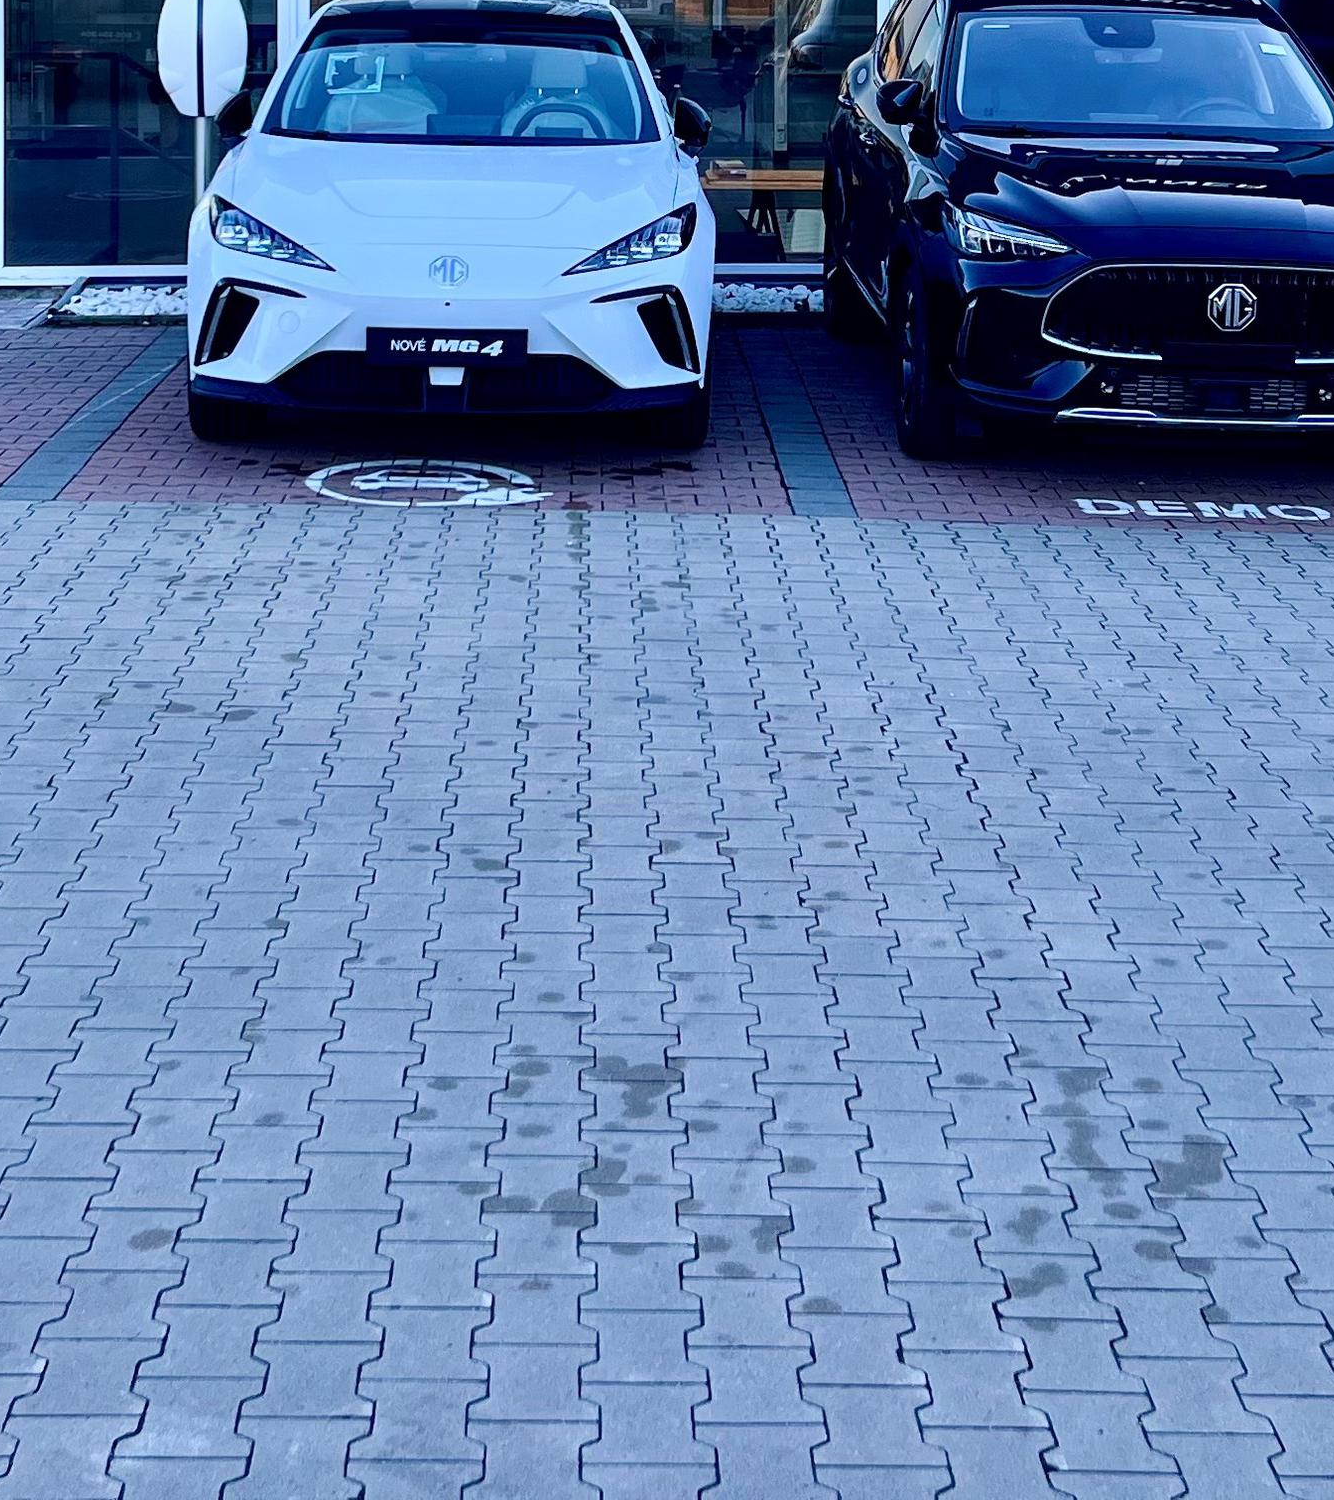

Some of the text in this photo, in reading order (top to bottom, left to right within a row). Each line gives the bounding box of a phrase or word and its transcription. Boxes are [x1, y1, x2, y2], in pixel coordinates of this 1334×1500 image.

[433, 258, 465, 284] MG
[1212, 287, 1253, 327] MG
[390, 337, 427, 352] NOVÉ
[1072, 498, 1332, 521] DEMO
